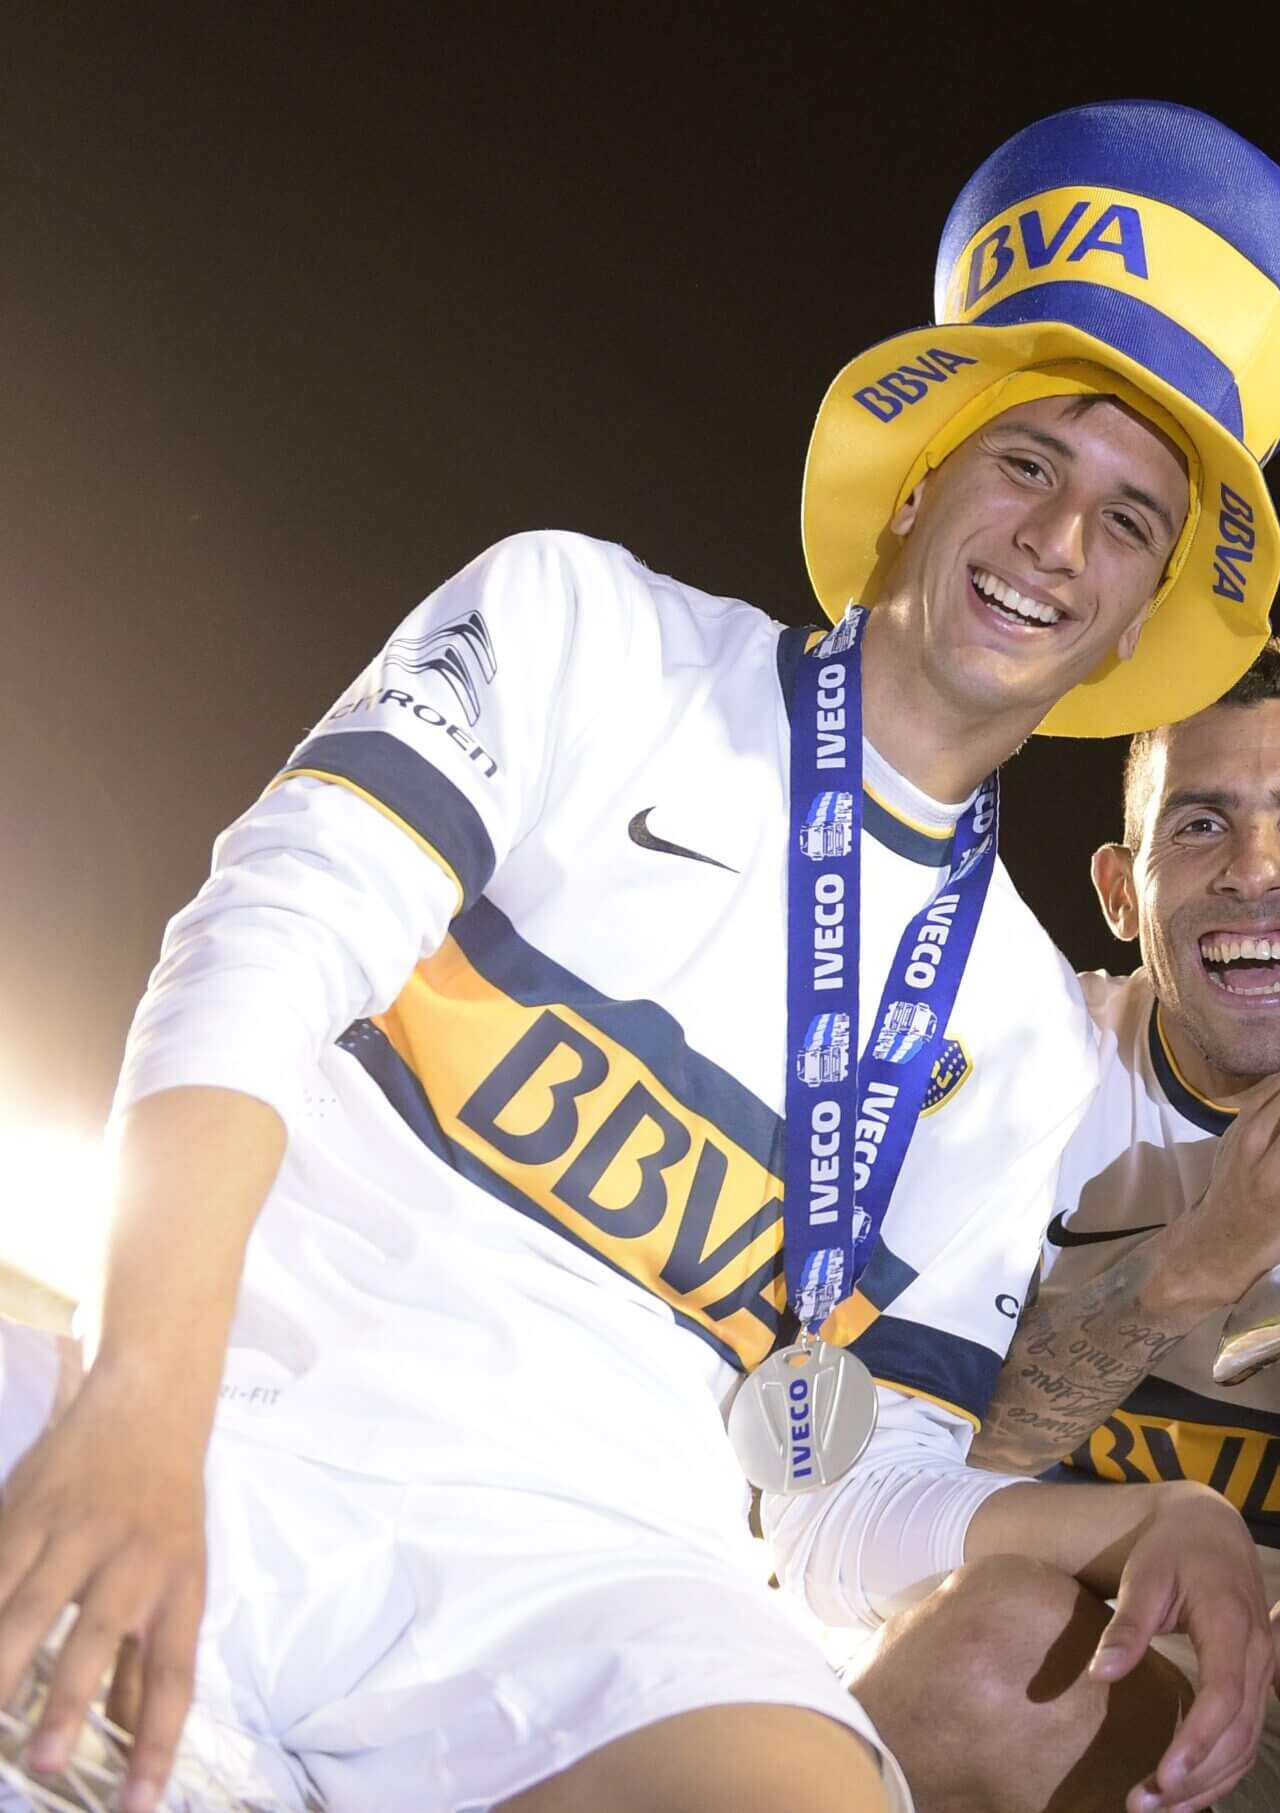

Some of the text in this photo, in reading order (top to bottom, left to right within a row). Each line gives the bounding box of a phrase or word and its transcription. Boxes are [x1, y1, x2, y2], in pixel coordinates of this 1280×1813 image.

[964, 201, 1149, 313] BVA
[852, 347, 979, 424] BBVA
[1212, 482, 1257, 604] BBVA
[816, 663, 847, 770] IVECO
[814, 872, 845, 991] IVECO
[904, 893, 961, 990] IVECO
[456, 1008, 790, 1340] BBVA
[809, 1100, 841, 1226] IVECO
[853, 1081, 900, 1192] IVECO
[789, 1378, 812, 1479] IVECO
